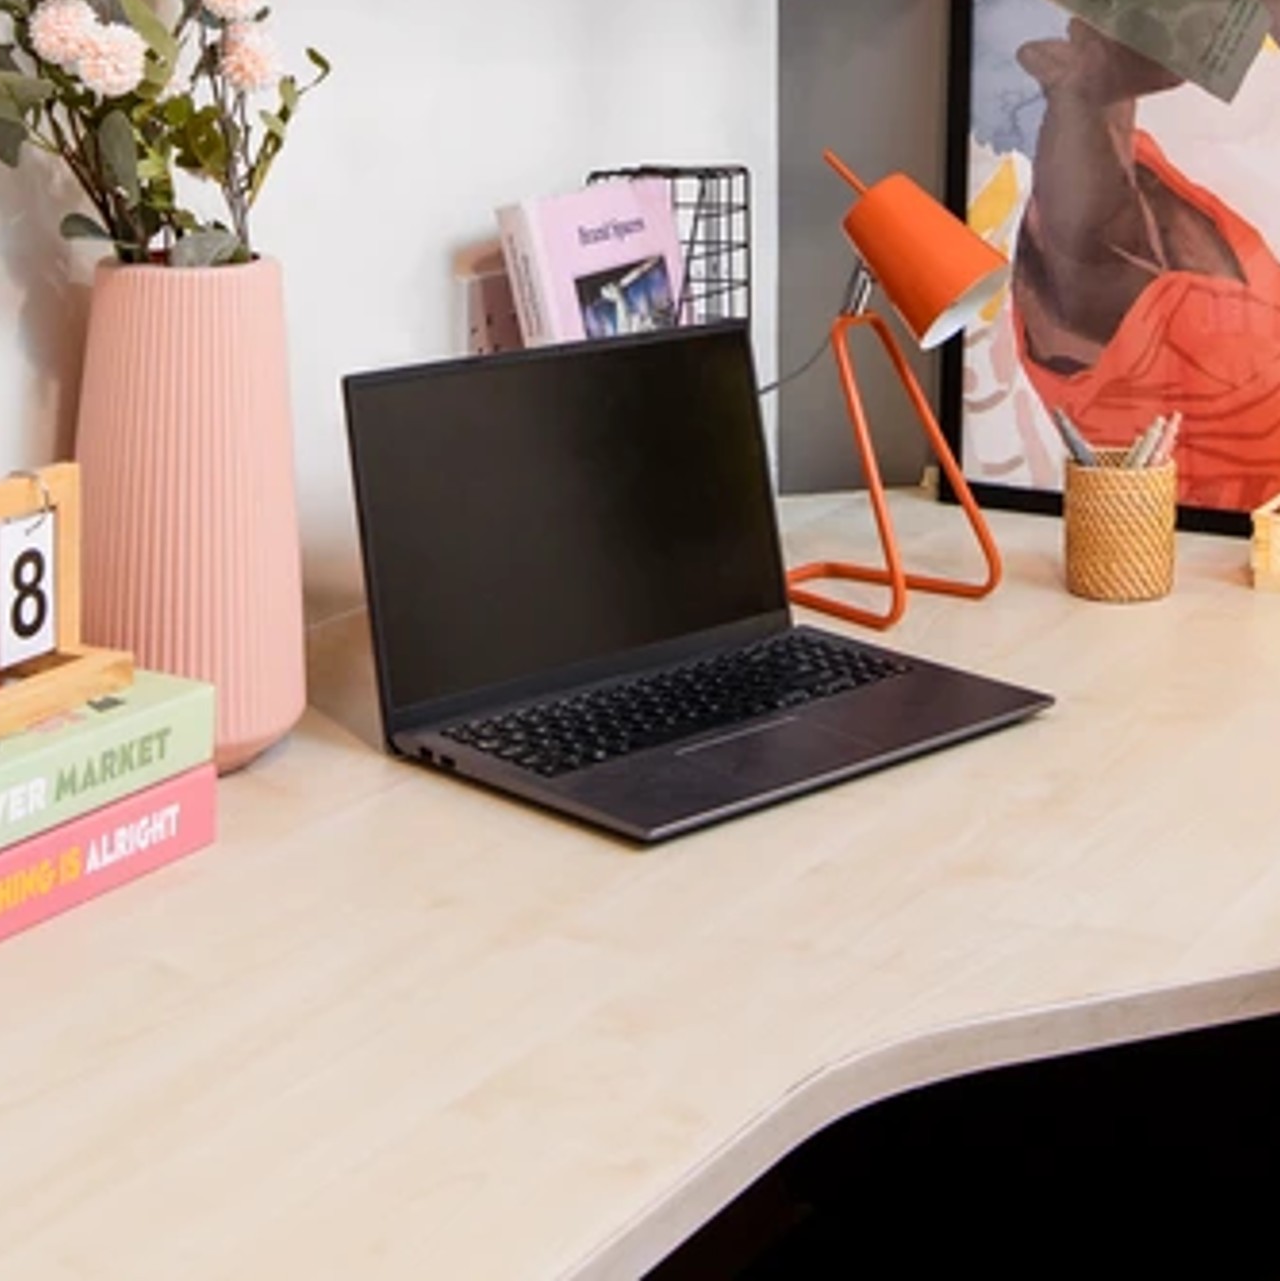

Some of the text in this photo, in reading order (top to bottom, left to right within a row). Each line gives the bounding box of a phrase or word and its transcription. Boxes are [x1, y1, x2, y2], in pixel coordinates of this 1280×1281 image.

[54, 726, 172, 802] MARKET
[58, 845, 82, 886] IS
[86, 803, 180, 874] ALRIGHT
